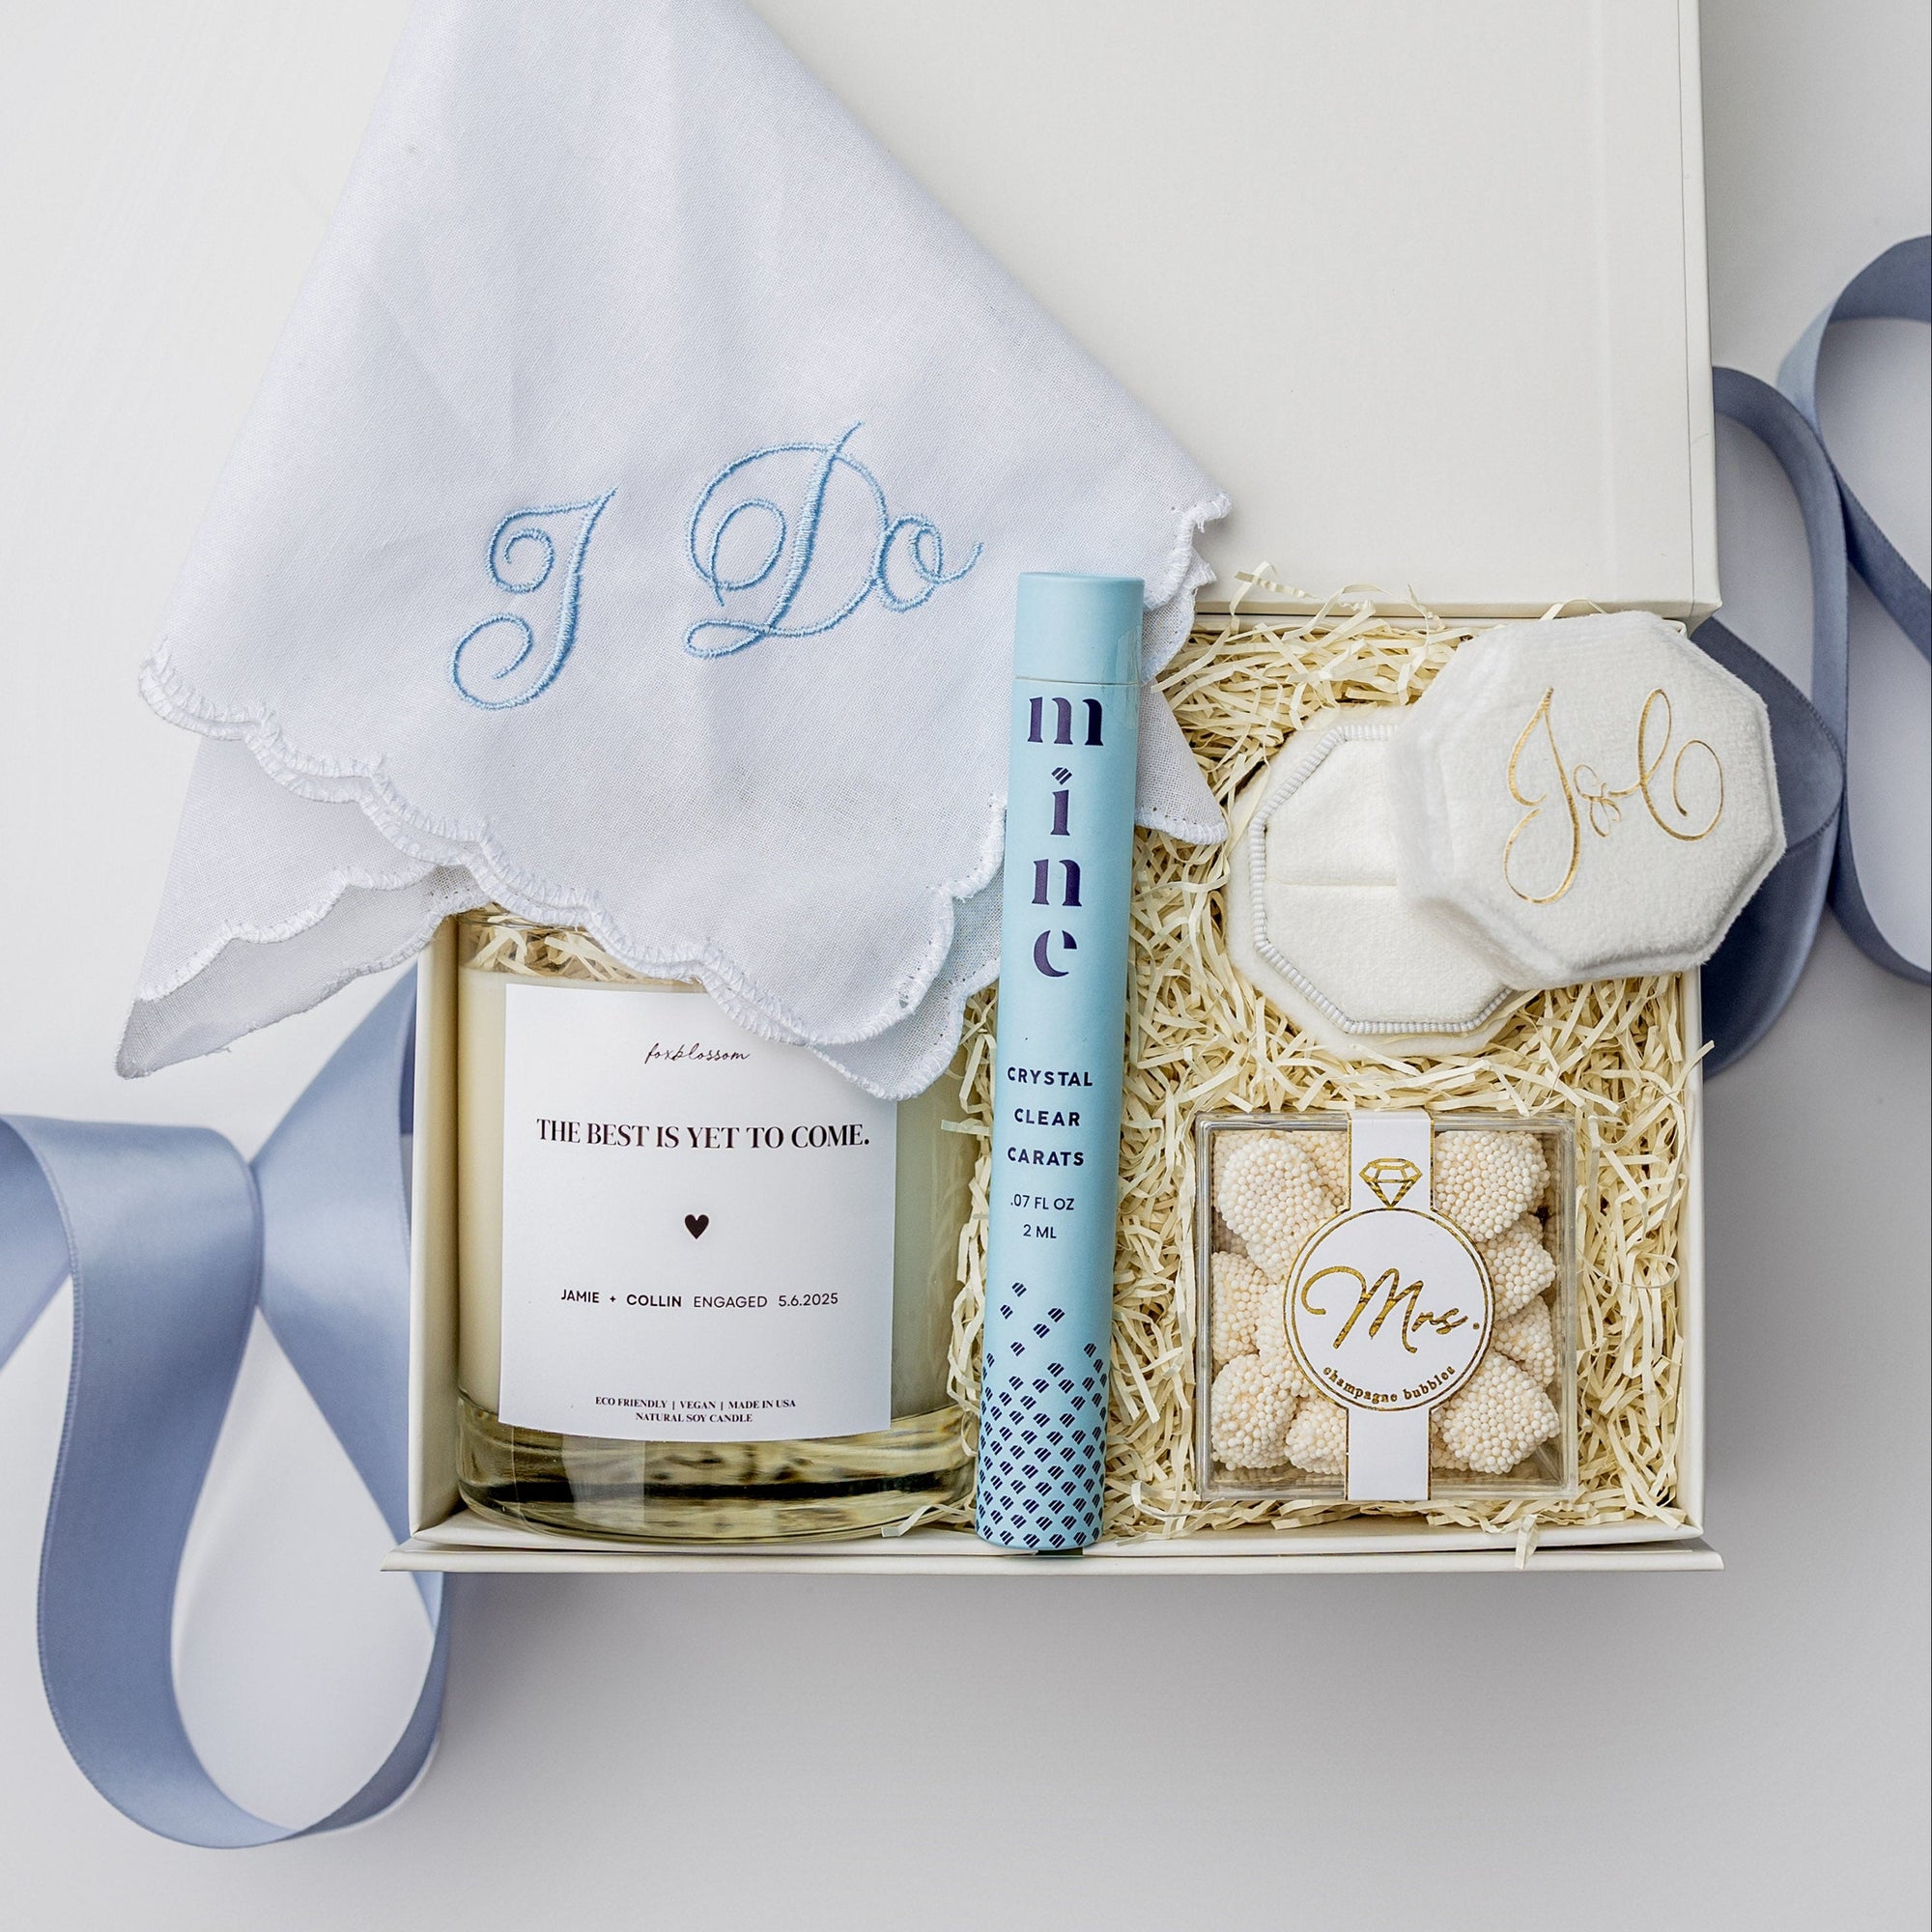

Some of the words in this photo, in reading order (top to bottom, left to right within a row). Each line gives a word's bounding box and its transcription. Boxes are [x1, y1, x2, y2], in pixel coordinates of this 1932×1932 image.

[683, 420, 983, 659] Do
[1027, 696, 1104, 978] mine
[644, 1042, 750, 1065] foxblossom
[1008, 1066, 1093, 1087] CRYSTAL
[1014, 1108, 1080, 1126] CLEAR
[536, 1118, 581, 1144] THE
[586, 1122, 650, 1147] BEST
[656, 1125, 680, 1148] IS
[687, 1126, 740, 1149] YET
[746, 1126, 784, 1149] TO
[791, 1123, 869, 1148] COME.
[1008, 1147, 1084, 1167] CARATS
[1010, 1193, 1030, 1208] .07
[1034, 1197, 1049, 1210] FL
[1053, 1198, 1075, 1210] OZ
[1023, 1224, 1032, 1237] 2
[1036, 1226, 1057, 1238] ML
[561, 1289, 600, 1303] JAMIE
[626, 1293, 682, 1307] COLLIN
[693, 1295, 768, 1308] ENGAGED
[779, 1293, 838, 1307] 5.6.2025
[1301, 1265, 1480, 1354] Mrs.
[1322, 1367, 1398, 1405] champagne
[1403, 1366, 1456, 1400] bubbles
[595, 1396, 615, 1406] ECO
[617, 1398, 668, 1408] FRIENDLY
[679, 1401, 716, 1409] VEGAN
[727, 1401, 760, 1409] MADE
[762, 1400, 773, 1408] IN
[776, 1400, 796, 1408] USA
[636, 1412, 685, 1423] NATURAL
[686, 1413, 707, 1423] SOY
[709, 1413, 753, 1423] CANDLE
